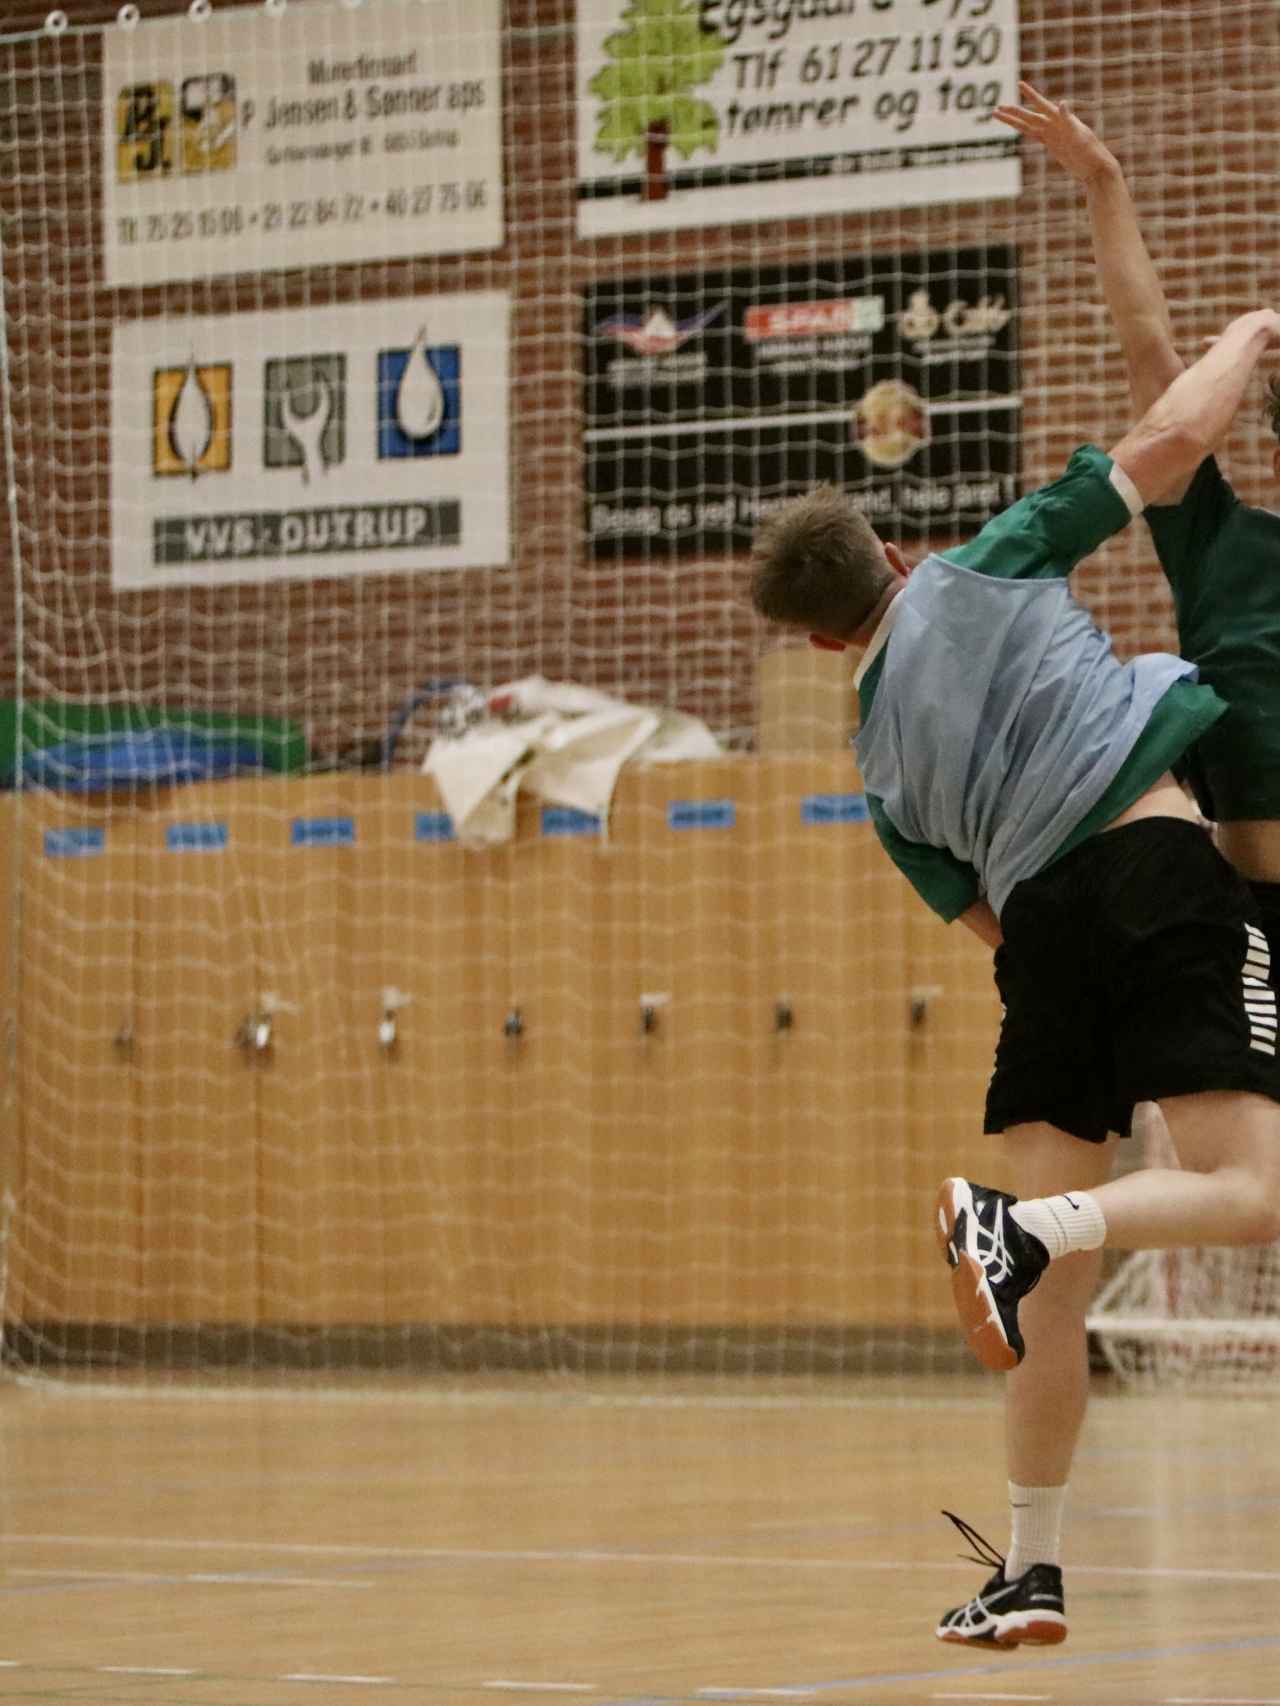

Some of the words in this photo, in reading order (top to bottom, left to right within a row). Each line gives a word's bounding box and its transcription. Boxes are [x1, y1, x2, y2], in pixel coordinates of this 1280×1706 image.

[732, 50, 783, 91] Tlf
[799, 42, 843, 84] 61
[852, 35, 902, 79] 27
[909, 32, 944, 73] 11
[952, 24, 1002, 69] 50
[873, 87, 921, 132] og
[938, 74, 1003, 124] tag
[279, 506, 428, 550] OUTRUP
